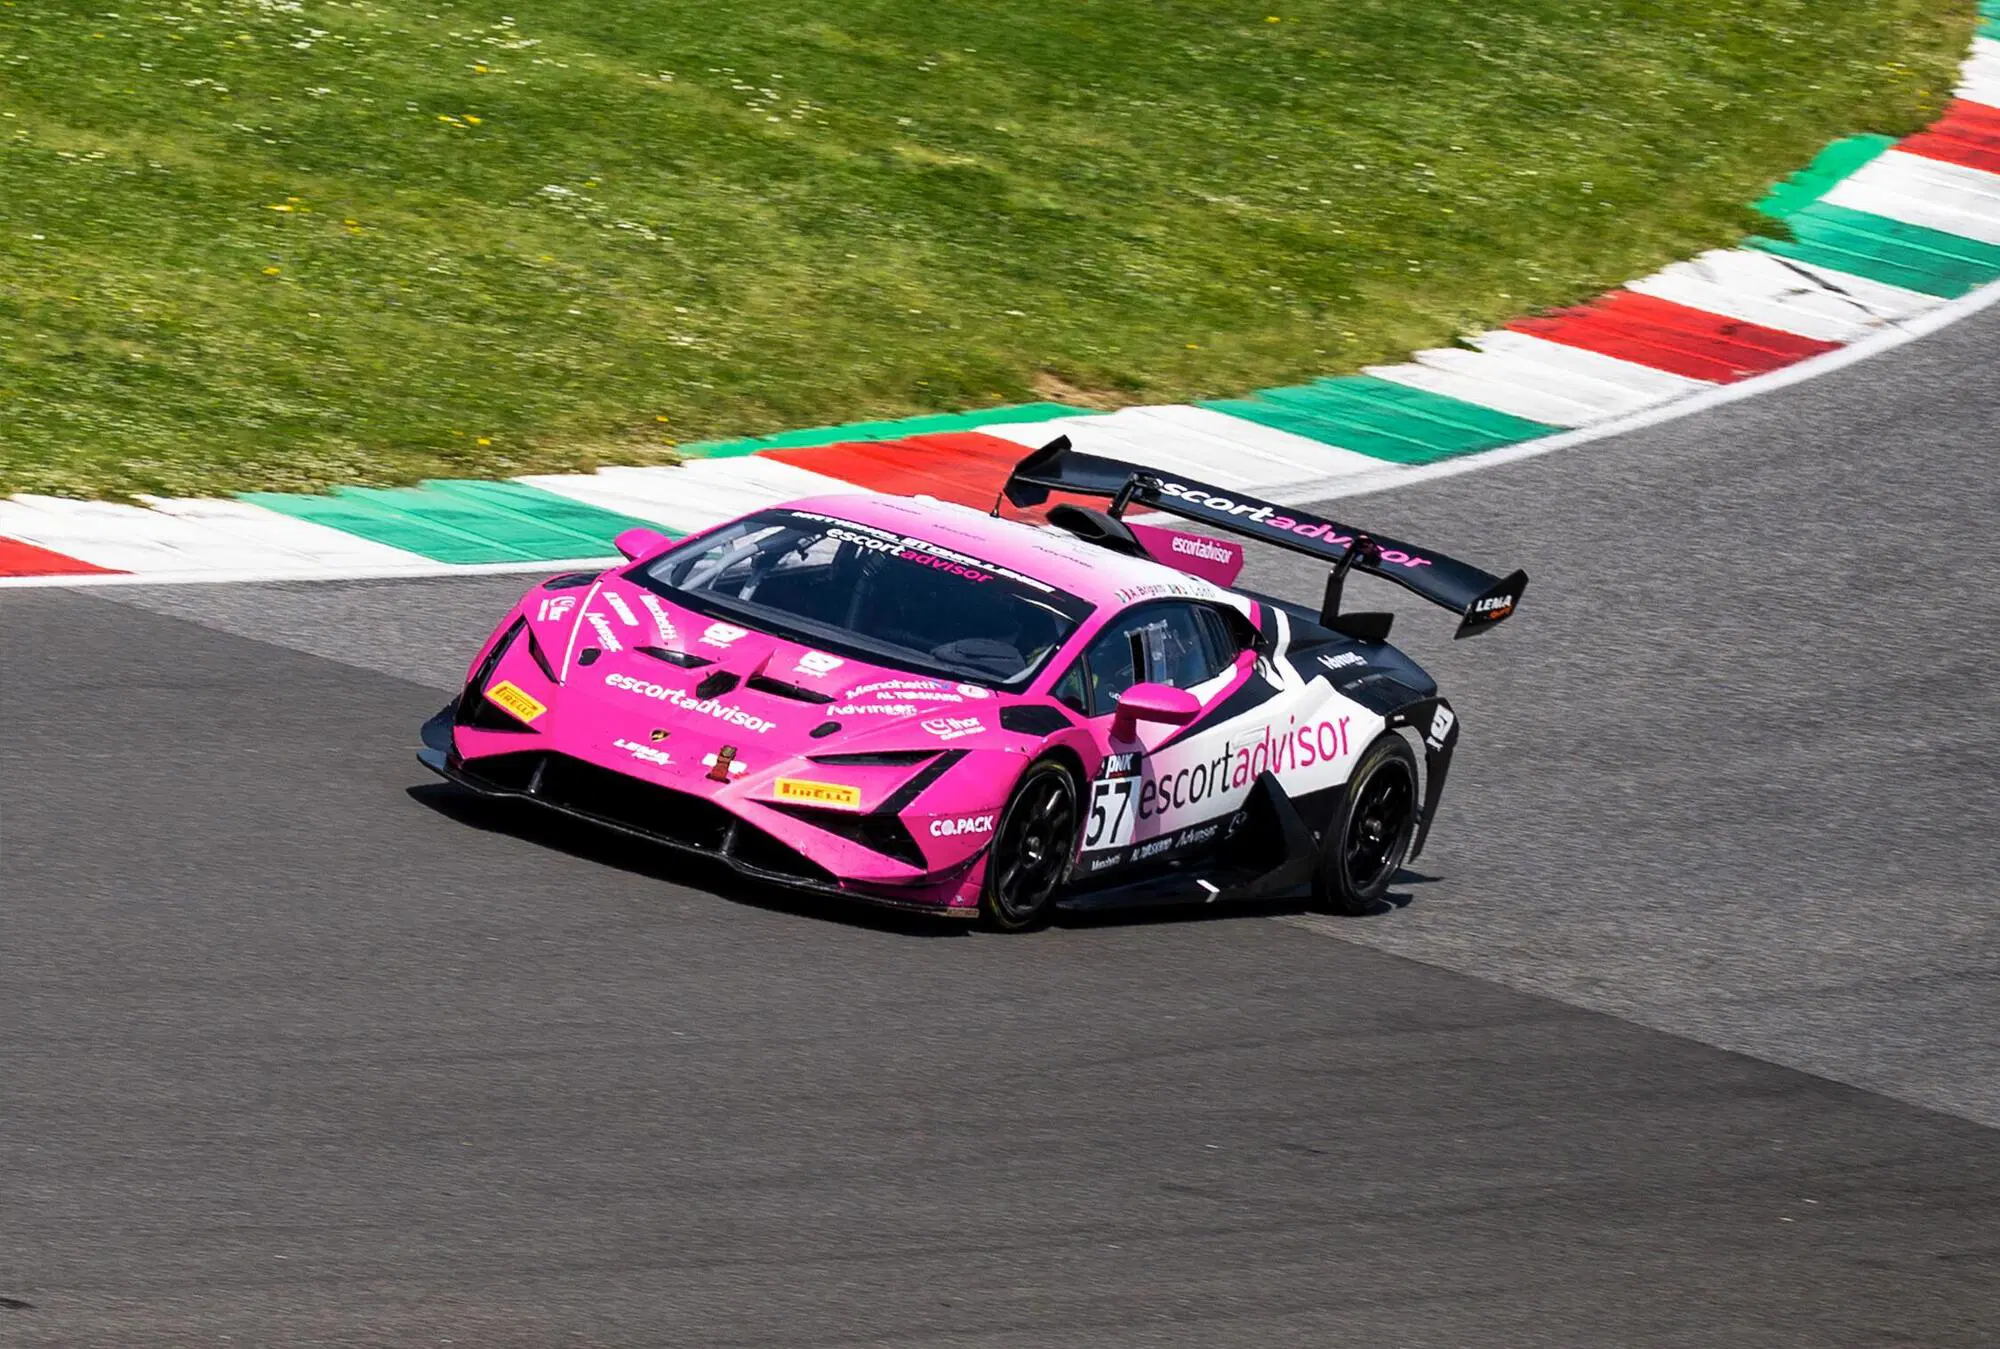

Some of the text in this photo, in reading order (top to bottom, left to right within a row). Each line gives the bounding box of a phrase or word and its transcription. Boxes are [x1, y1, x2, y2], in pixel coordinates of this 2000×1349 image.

[826, 528, 994, 584] escortadvisor
[1171, 536, 1234, 564] escortadvisor
[1475, 594, 1513, 612] LEMA
[604, 672, 777, 734] escortadvisor
[1139, 715, 1351, 819] escortadvisor
[929, 815, 994, 837] CO.PACK
[1084, 780, 1133, 847] 57
